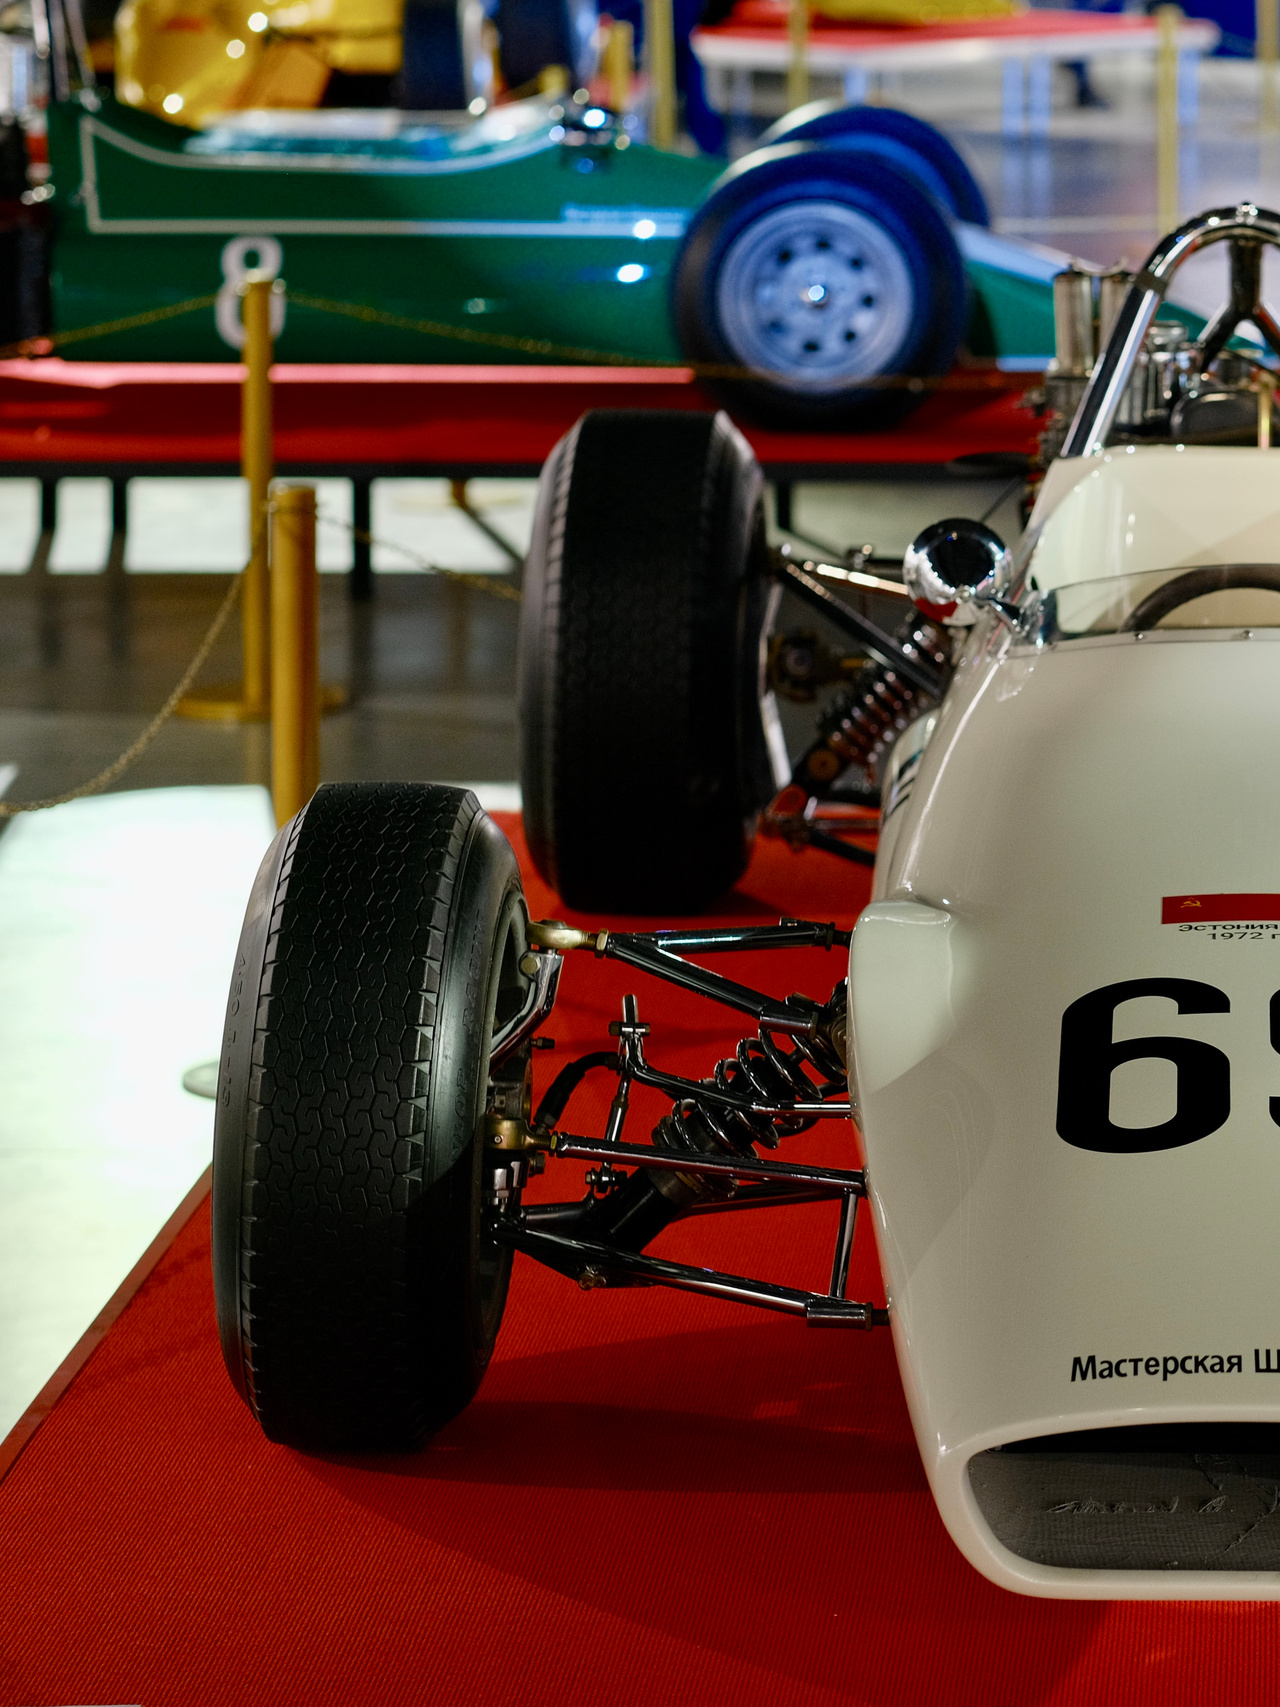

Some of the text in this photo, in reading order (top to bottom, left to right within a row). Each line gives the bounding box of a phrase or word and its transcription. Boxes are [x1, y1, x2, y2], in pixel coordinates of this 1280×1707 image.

[214, 235, 287, 352] 8
[1207, 932, 1264, 940] 1972
[1070, 1354, 1243, 1382] Мастерская
